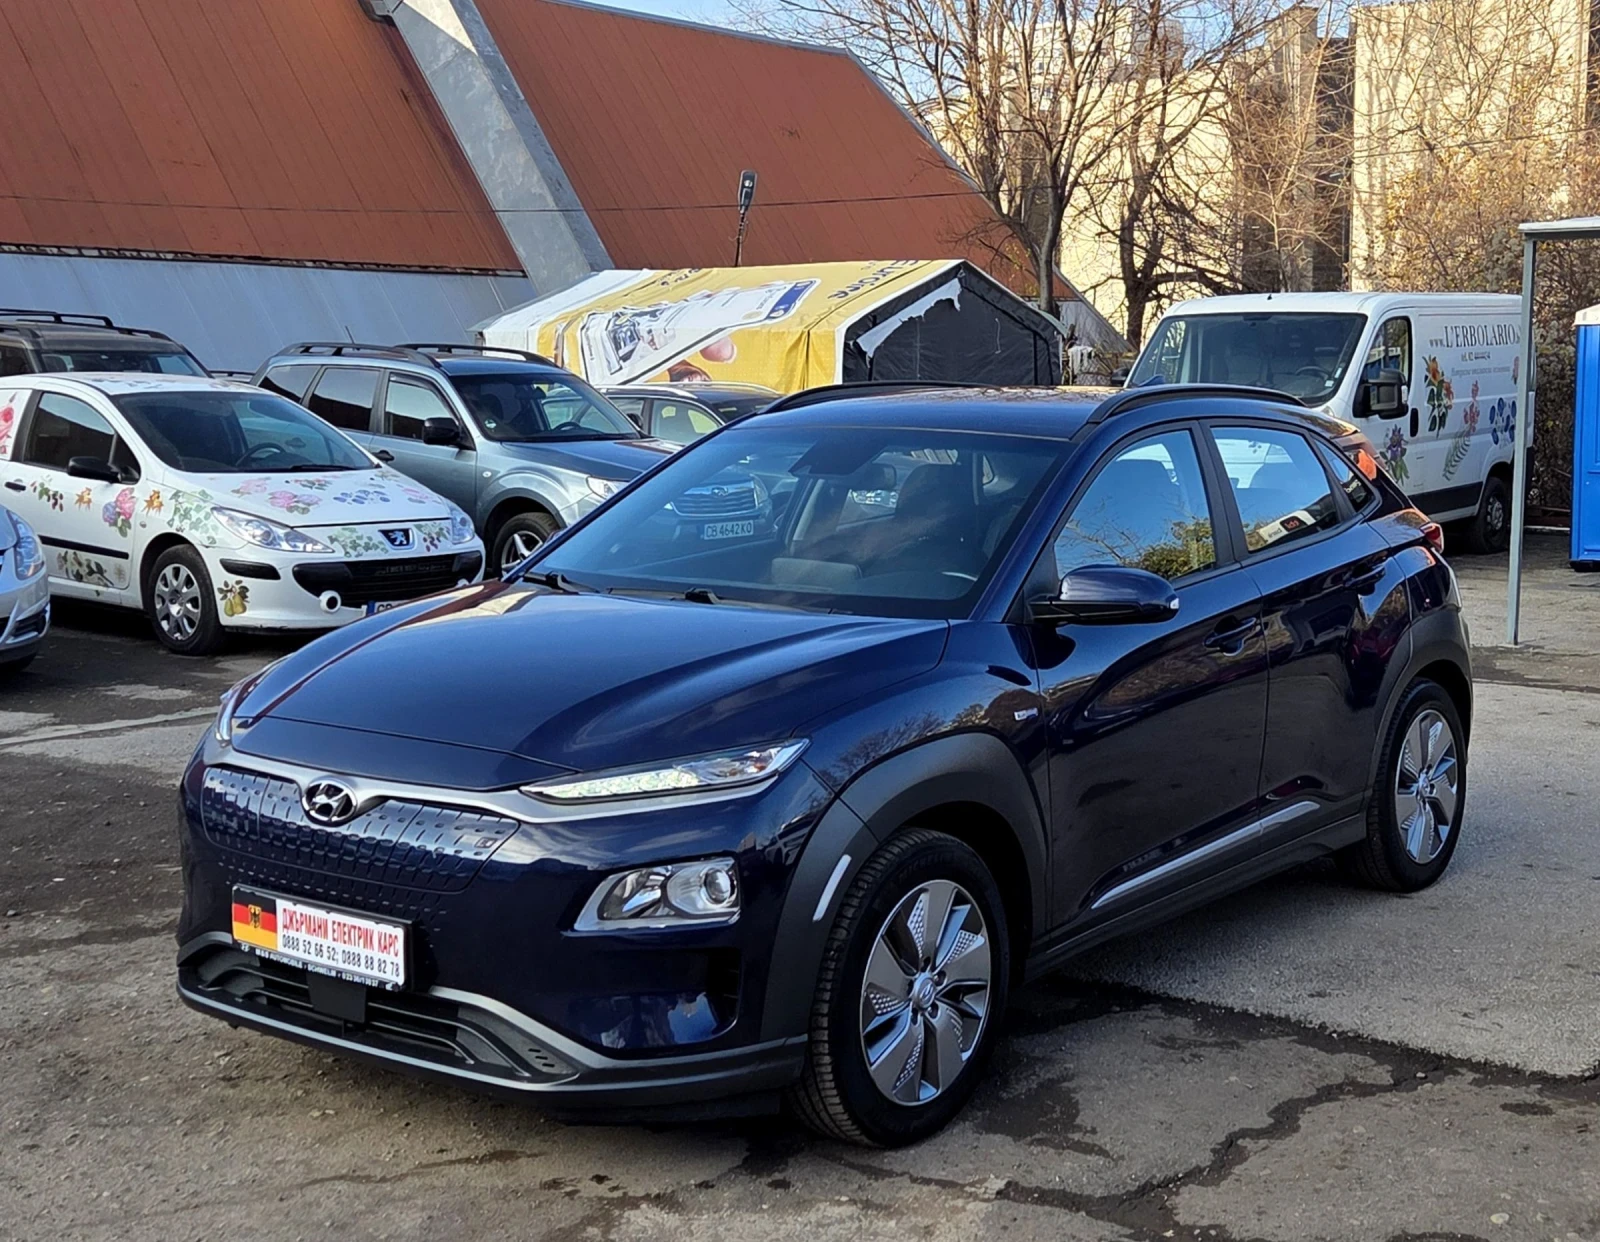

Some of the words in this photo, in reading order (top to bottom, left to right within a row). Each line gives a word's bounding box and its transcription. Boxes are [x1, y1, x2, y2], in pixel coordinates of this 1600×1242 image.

[282, 908, 329, 940] ДЖЪРМАНИ
[332, 920, 375, 952] ЕЛЕКТРИК
[378, 930, 399, 958] КАРС
[282, 934, 300, 952] 0888
[303, 939, 312, 955] 52
[314, 942, 324, 958] 66
[341, 949, 361, 968] 0888
[364, 955, 375, 971] 88
[377, 958, 387, 974] 82
[390, 961, 400, 977] 78
